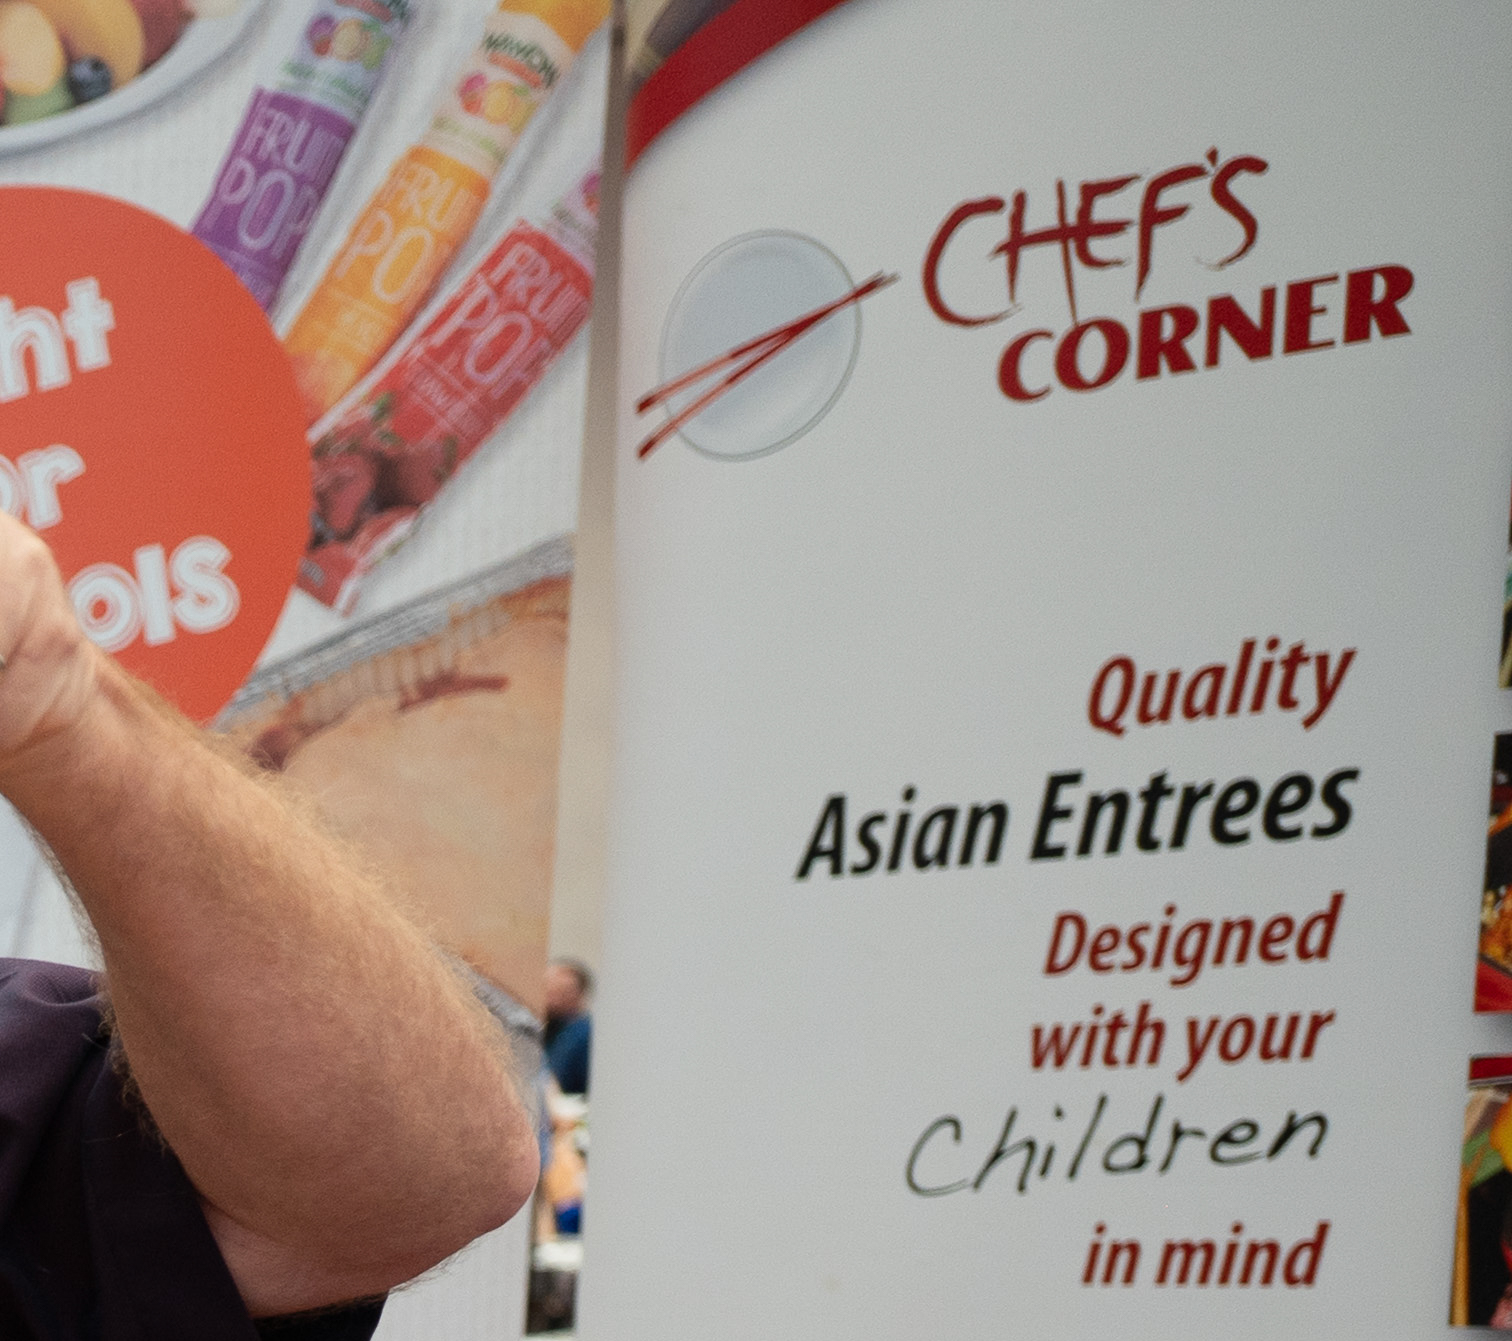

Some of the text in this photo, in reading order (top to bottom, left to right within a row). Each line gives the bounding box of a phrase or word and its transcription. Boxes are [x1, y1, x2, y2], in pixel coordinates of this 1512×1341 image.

[923, 148, 1268, 328] CHEF'S
[997, 263, 1414, 402] CORNER
[1088, 636, 1358, 738] Quality
[795, 765, 1361, 882] Asian Entrees
[1044, 891, 1346, 986] Designed
[1029, 1001, 1336, 1083] with your
[905, 1094, 1330, 1198] Children
[1081, 1221, 1331, 1289] in mind
